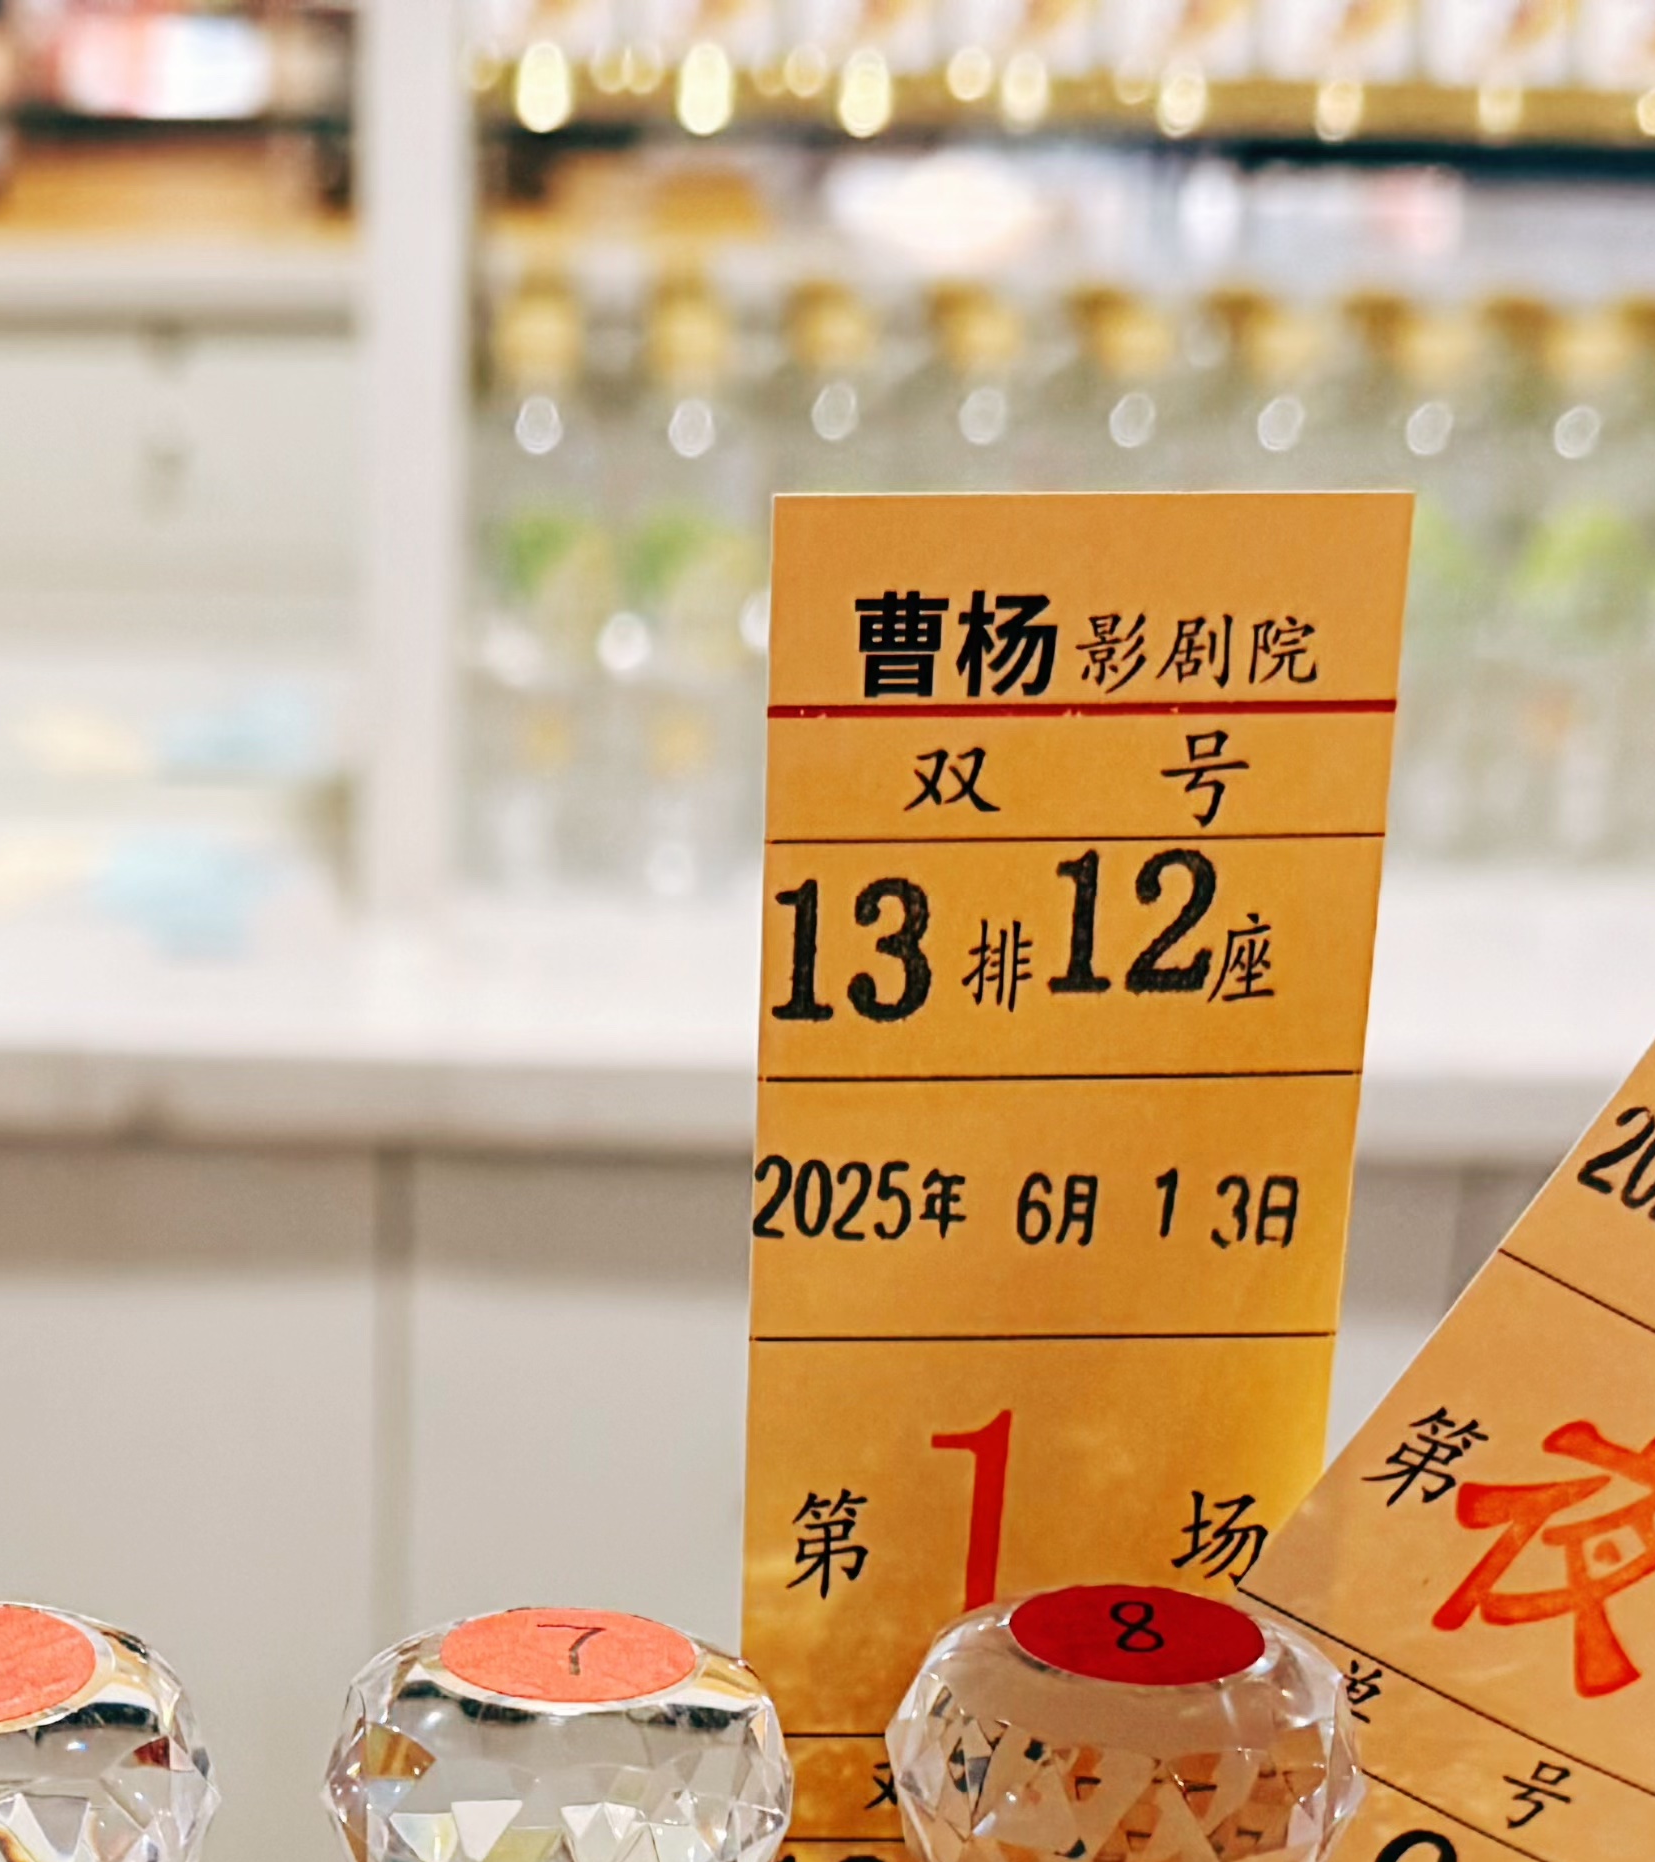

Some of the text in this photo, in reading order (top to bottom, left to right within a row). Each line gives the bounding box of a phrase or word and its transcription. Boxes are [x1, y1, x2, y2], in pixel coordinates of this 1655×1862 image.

[854, 589, 1319, 698] 曹杨影剧院
[770, 848, 1277, 1024] 13排12座
[752, 1154, 967, 1242] 2025年
[1015, 1171, 1100, 1248] 6月
[535, 1622, 607, 1676] 7
[1108, 1600, 1166, 1654] 8
